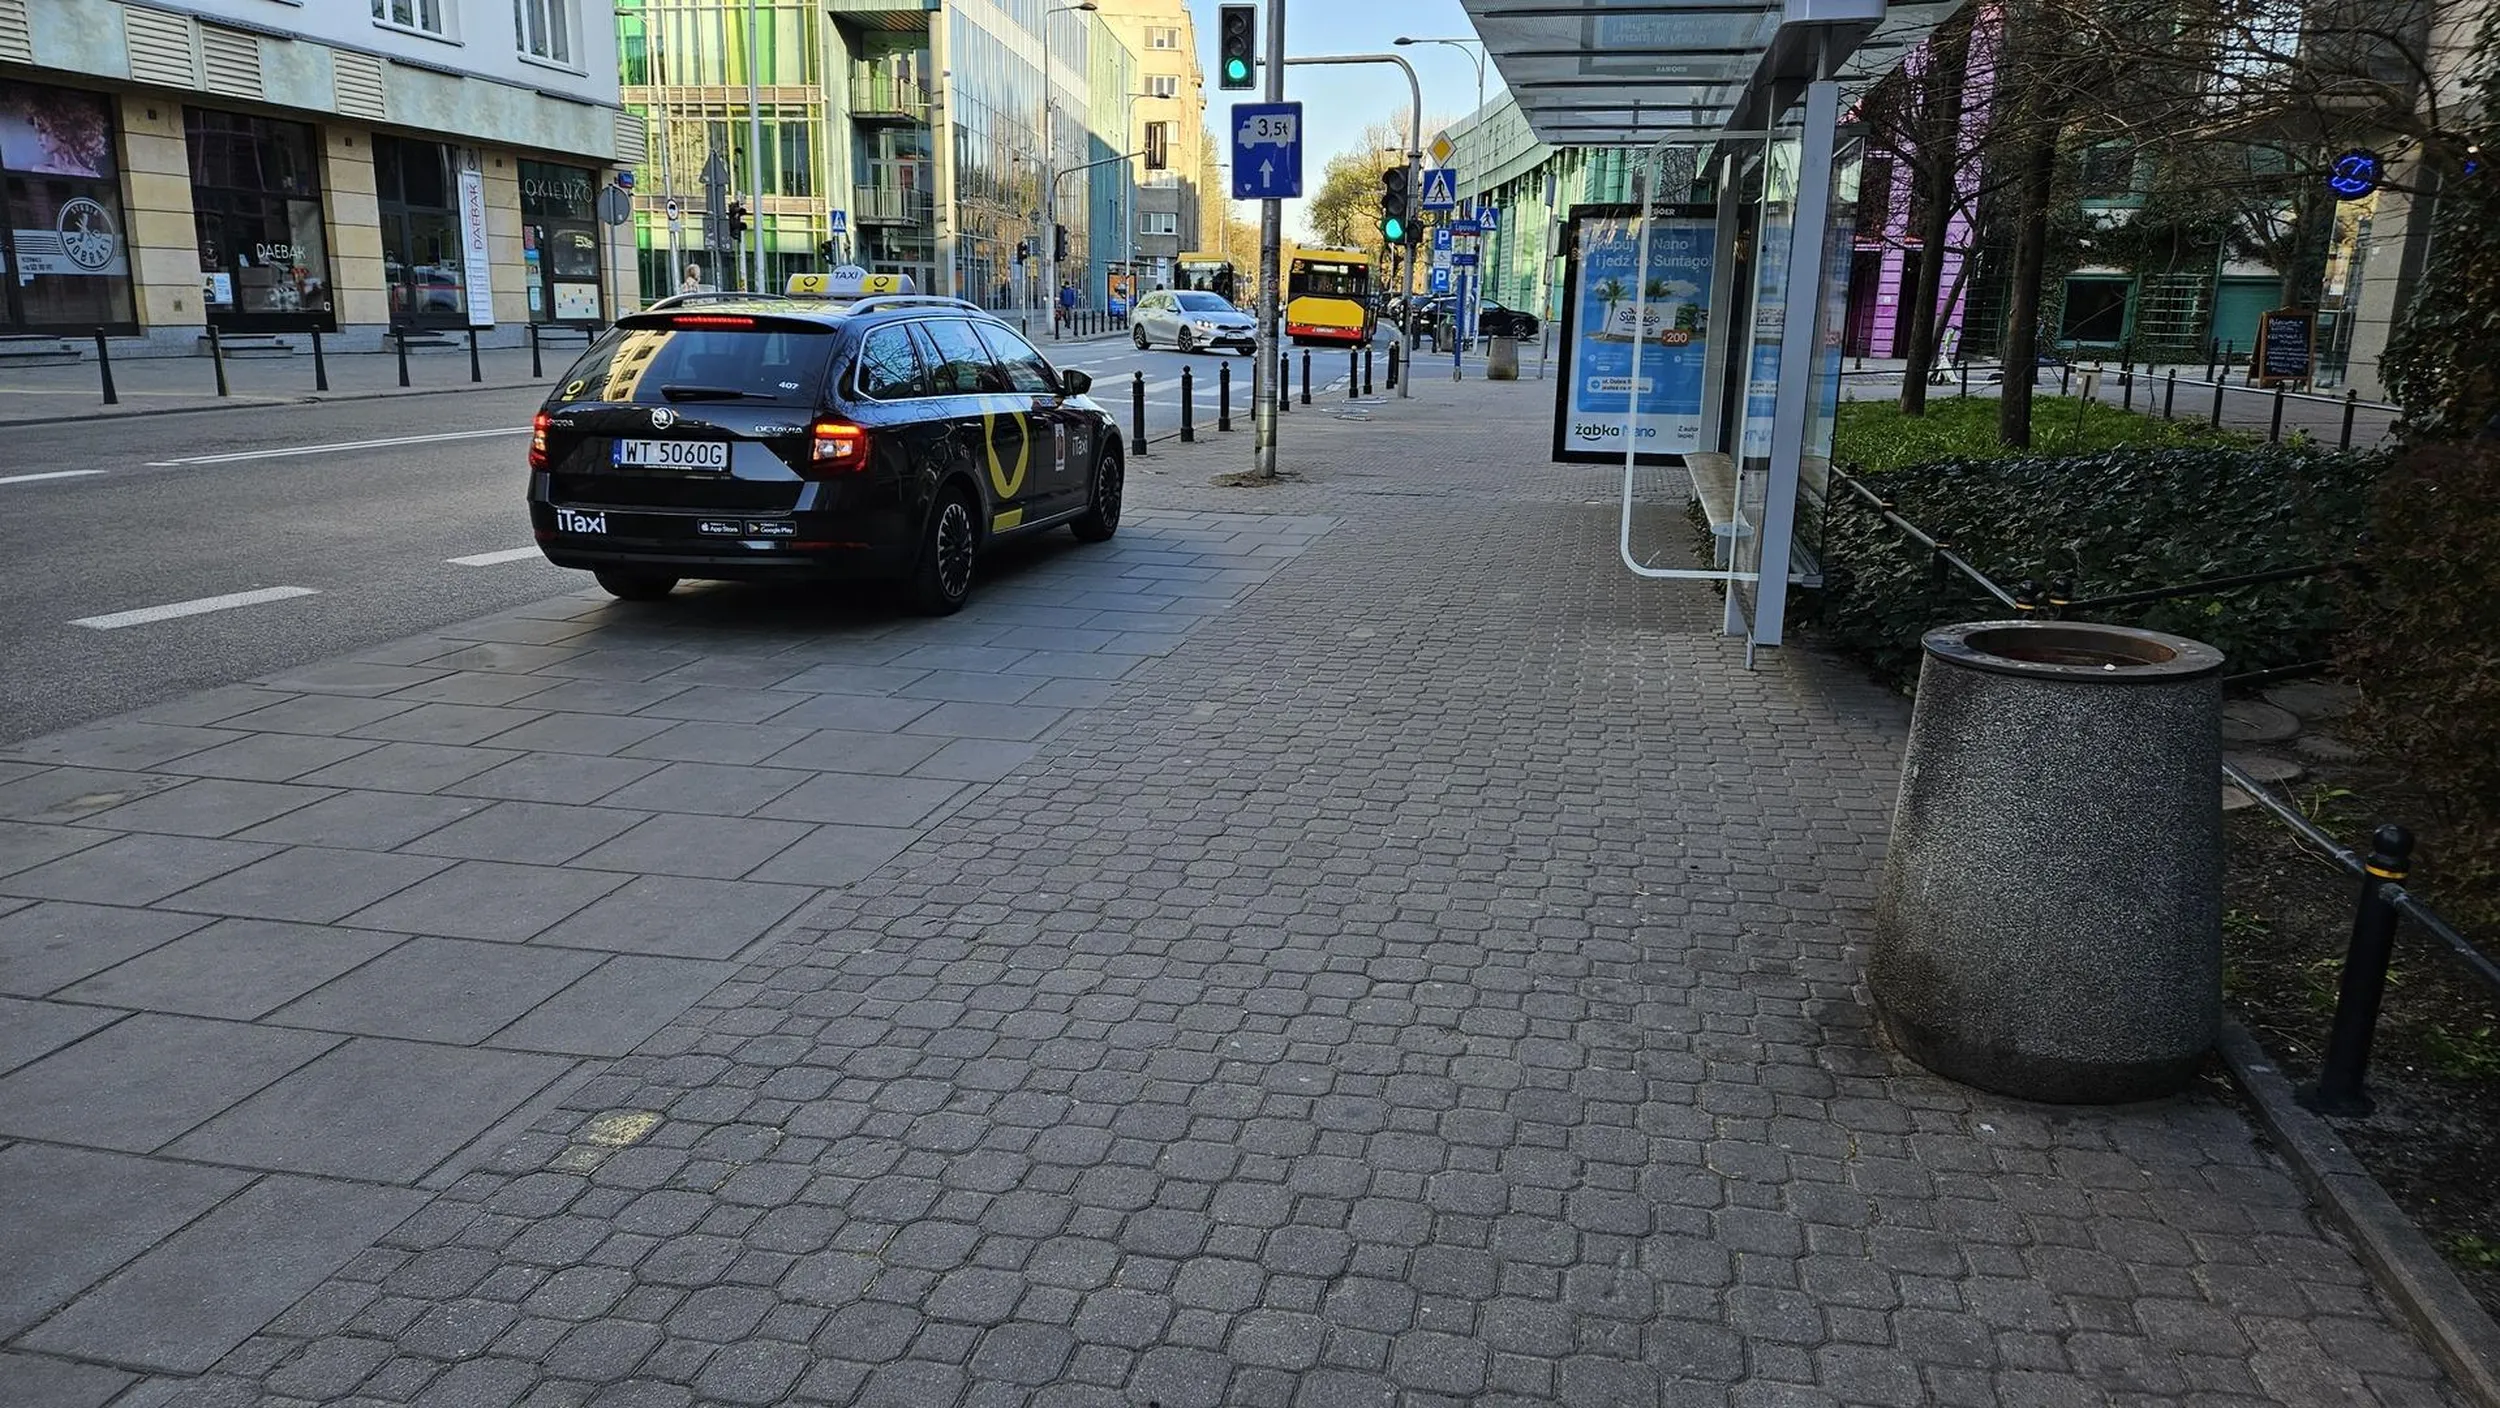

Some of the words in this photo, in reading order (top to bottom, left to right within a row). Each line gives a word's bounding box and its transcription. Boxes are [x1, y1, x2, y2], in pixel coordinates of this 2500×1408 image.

[467, 183, 483, 251] DAEBAK
[256, 243, 307, 259] DAEBAK
[1653, 239, 1689, 250] Nano
[1601, 254, 1631, 270] jedź
[834, 271, 859, 280] TAXI
[1619, 310, 1660, 324] SUNAGO
[778, 381, 800, 390] 407
[755, 425, 804, 433] OCTAVIA
[1575, 424, 1620, 436] żabka
[626, 442, 651, 462] WT
[659, 442, 723, 464] 5060G
[557, 509, 607, 534] iTaxi
[760, 526, 780, 534] Google
[781, 526, 794, 534] Play
